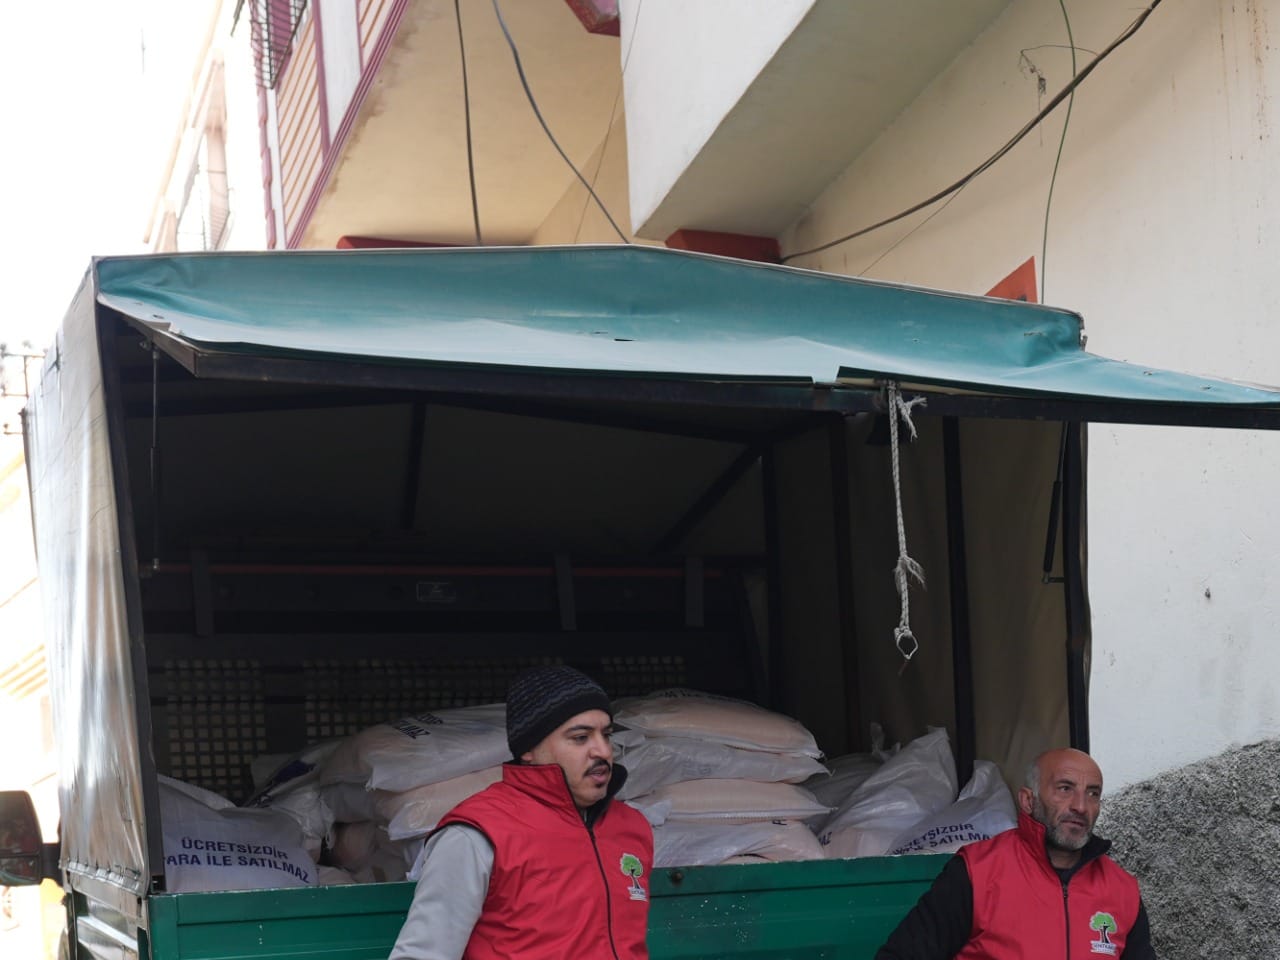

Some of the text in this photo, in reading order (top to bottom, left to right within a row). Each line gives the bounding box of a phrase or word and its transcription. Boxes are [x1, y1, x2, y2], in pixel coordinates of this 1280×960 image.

[181, 837, 288, 860] ÜCRETSİZDİR
[929, 832, 991, 848] SATILMA
[164, 853, 310, 884] ARA İLE SATILMAZ
